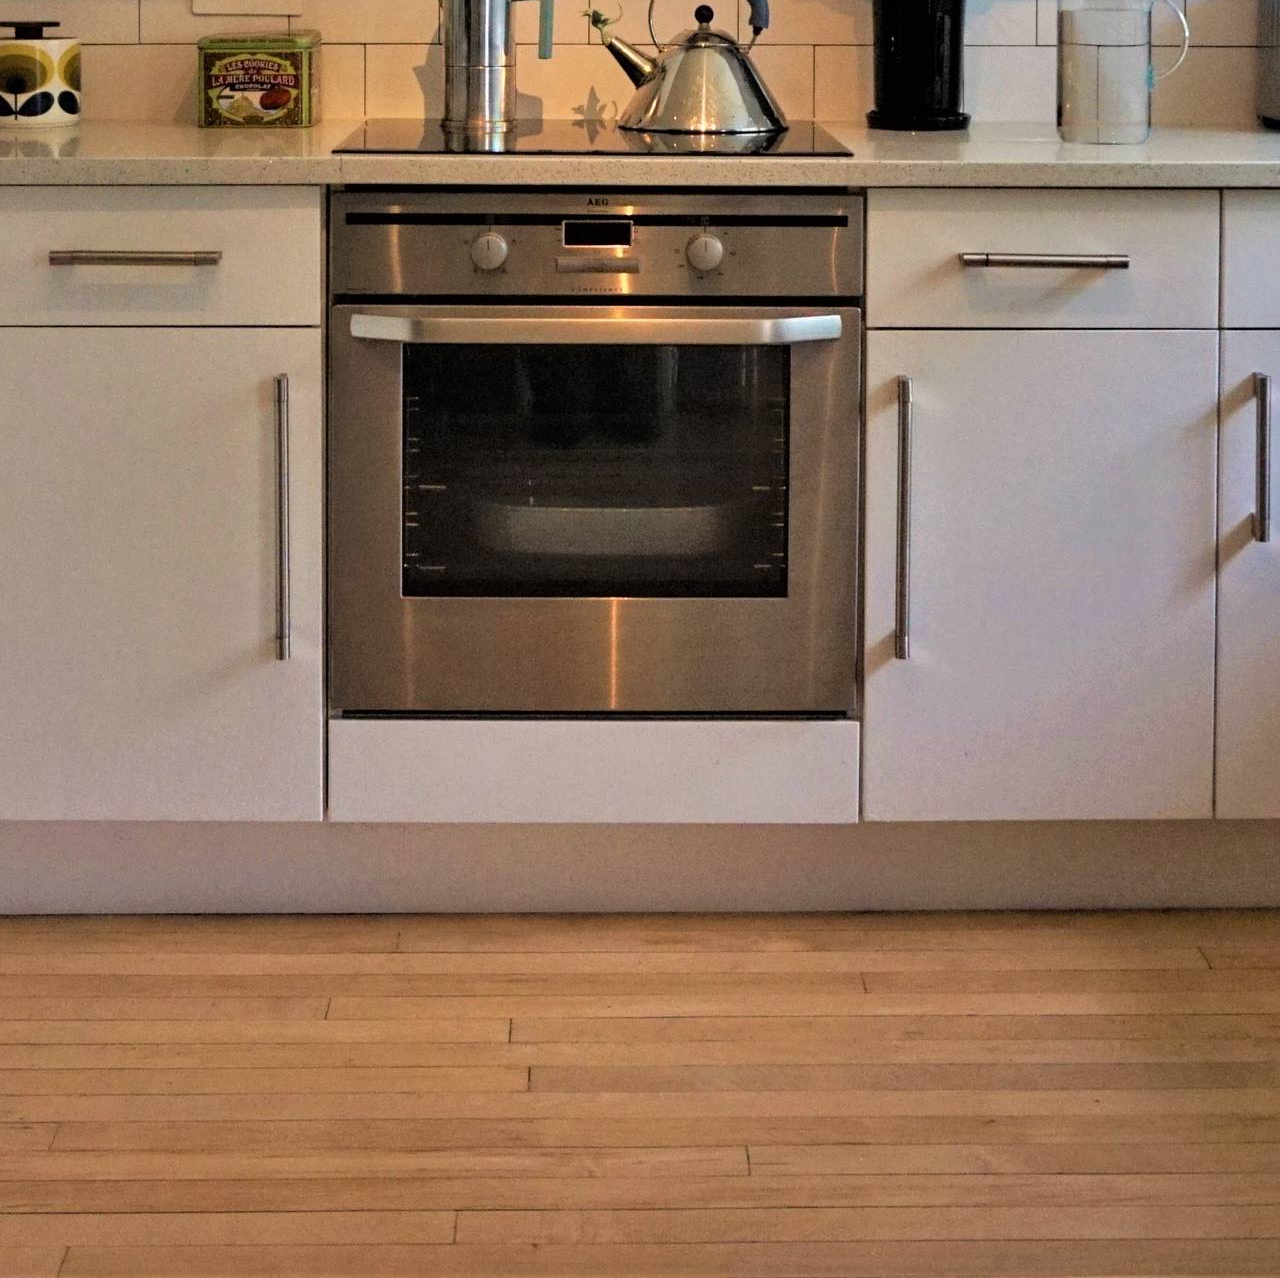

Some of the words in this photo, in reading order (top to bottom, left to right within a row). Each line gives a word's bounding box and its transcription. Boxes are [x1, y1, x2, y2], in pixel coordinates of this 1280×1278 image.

[211, 75, 224, 87] LA
[252, 74, 296, 86] POULARD
[586, 197, 609, 207] AEG
